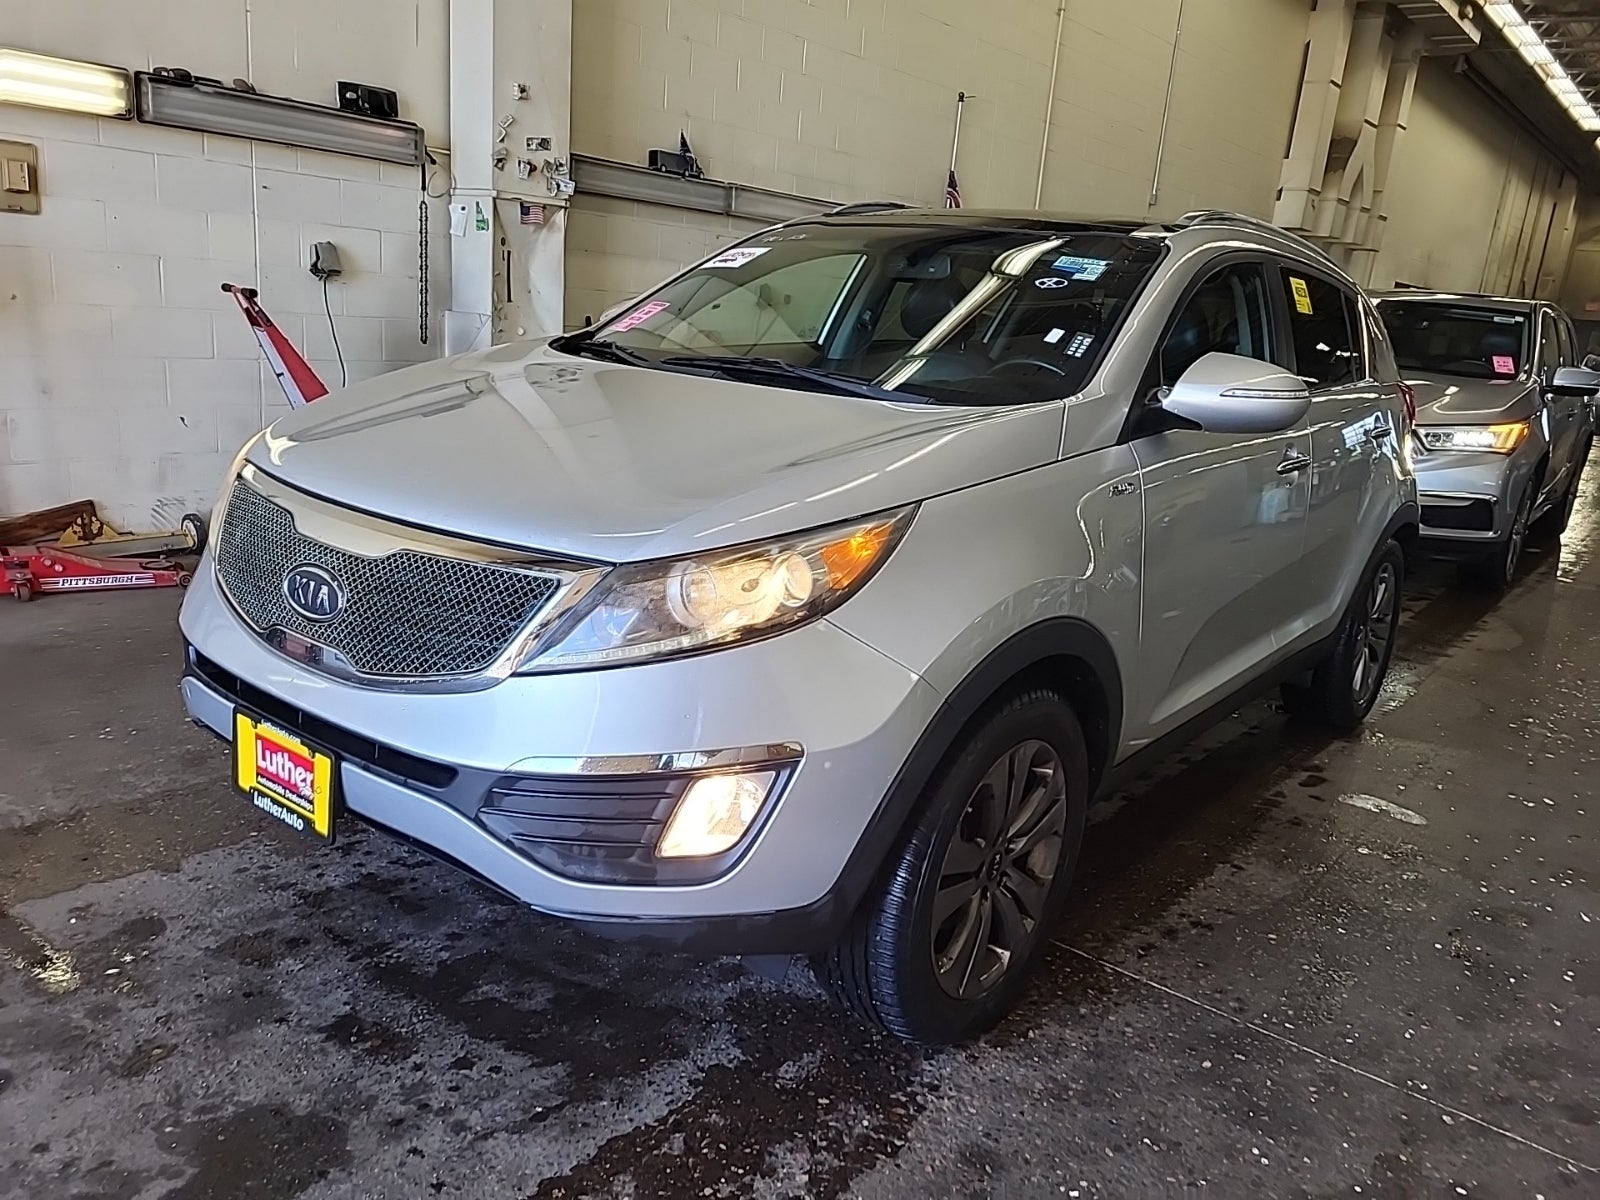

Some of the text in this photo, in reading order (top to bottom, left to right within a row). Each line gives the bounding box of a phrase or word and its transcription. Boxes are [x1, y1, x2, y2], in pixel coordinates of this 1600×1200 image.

[60, 575, 135, 587] PITTSBURGH
[294, 574, 331, 613] KIA
[257, 739, 314, 787] Luther
[253, 791, 304, 831] LutherAuto
